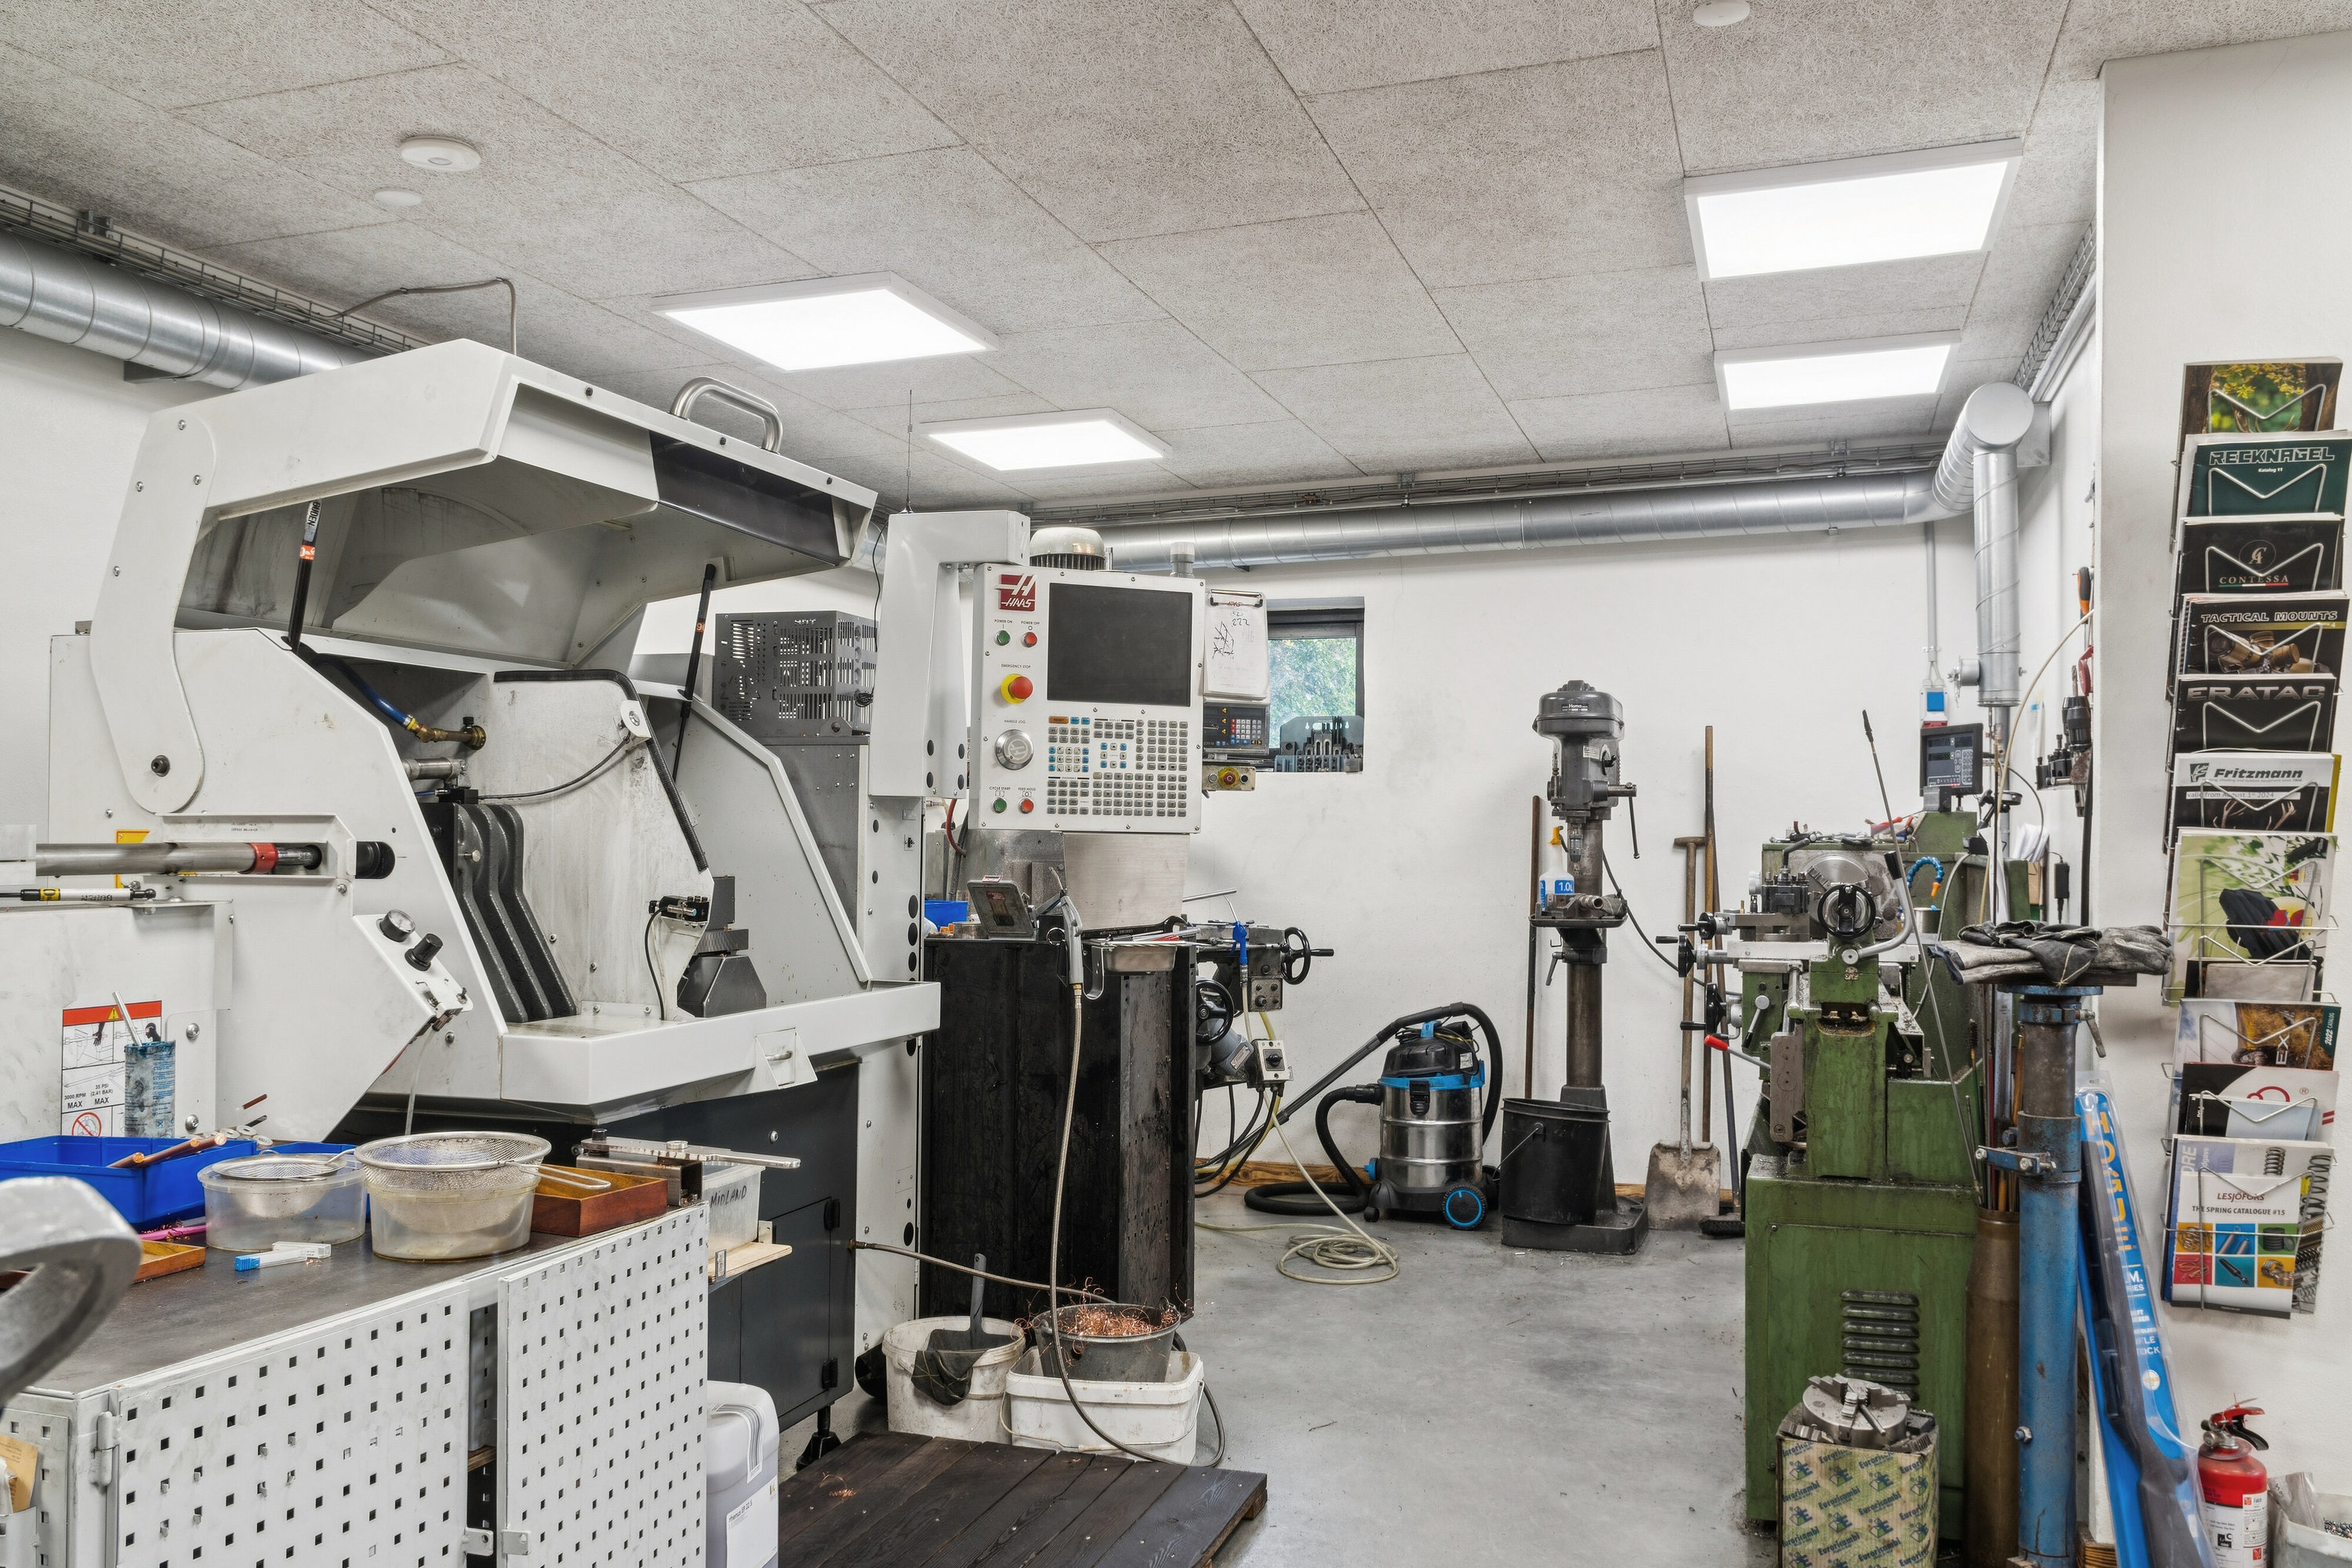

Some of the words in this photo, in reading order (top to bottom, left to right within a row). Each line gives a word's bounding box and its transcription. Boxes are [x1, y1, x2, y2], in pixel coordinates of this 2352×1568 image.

[2209, 447, 2335, 465] RECKNAGEL
[2220, 575, 2288, 584] CONTESSA
[1001, 597, 1035, 608] HAAS
[2201, 613, 2269, 623] TACTICAL
[2274, 611, 2337, 621] MOUNTS
[2187, 685, 2325, 702] ERATAC
[2214, 768, 2303, 778] Fritzmann
[2325, 1029, 2333, 1045] 2022
[67, 1101, 82, 1109] MAX
[94, 1097, 109, 1105] MAX
[1818, 1486, 1860, 1510] Euroricambi
[1858, 1491, 1901, 1516] Euroricambi
[1818, 1532, 1860, 1556] Euroricambi
[1858, 1537, 1901, 1562] Euroricambi
